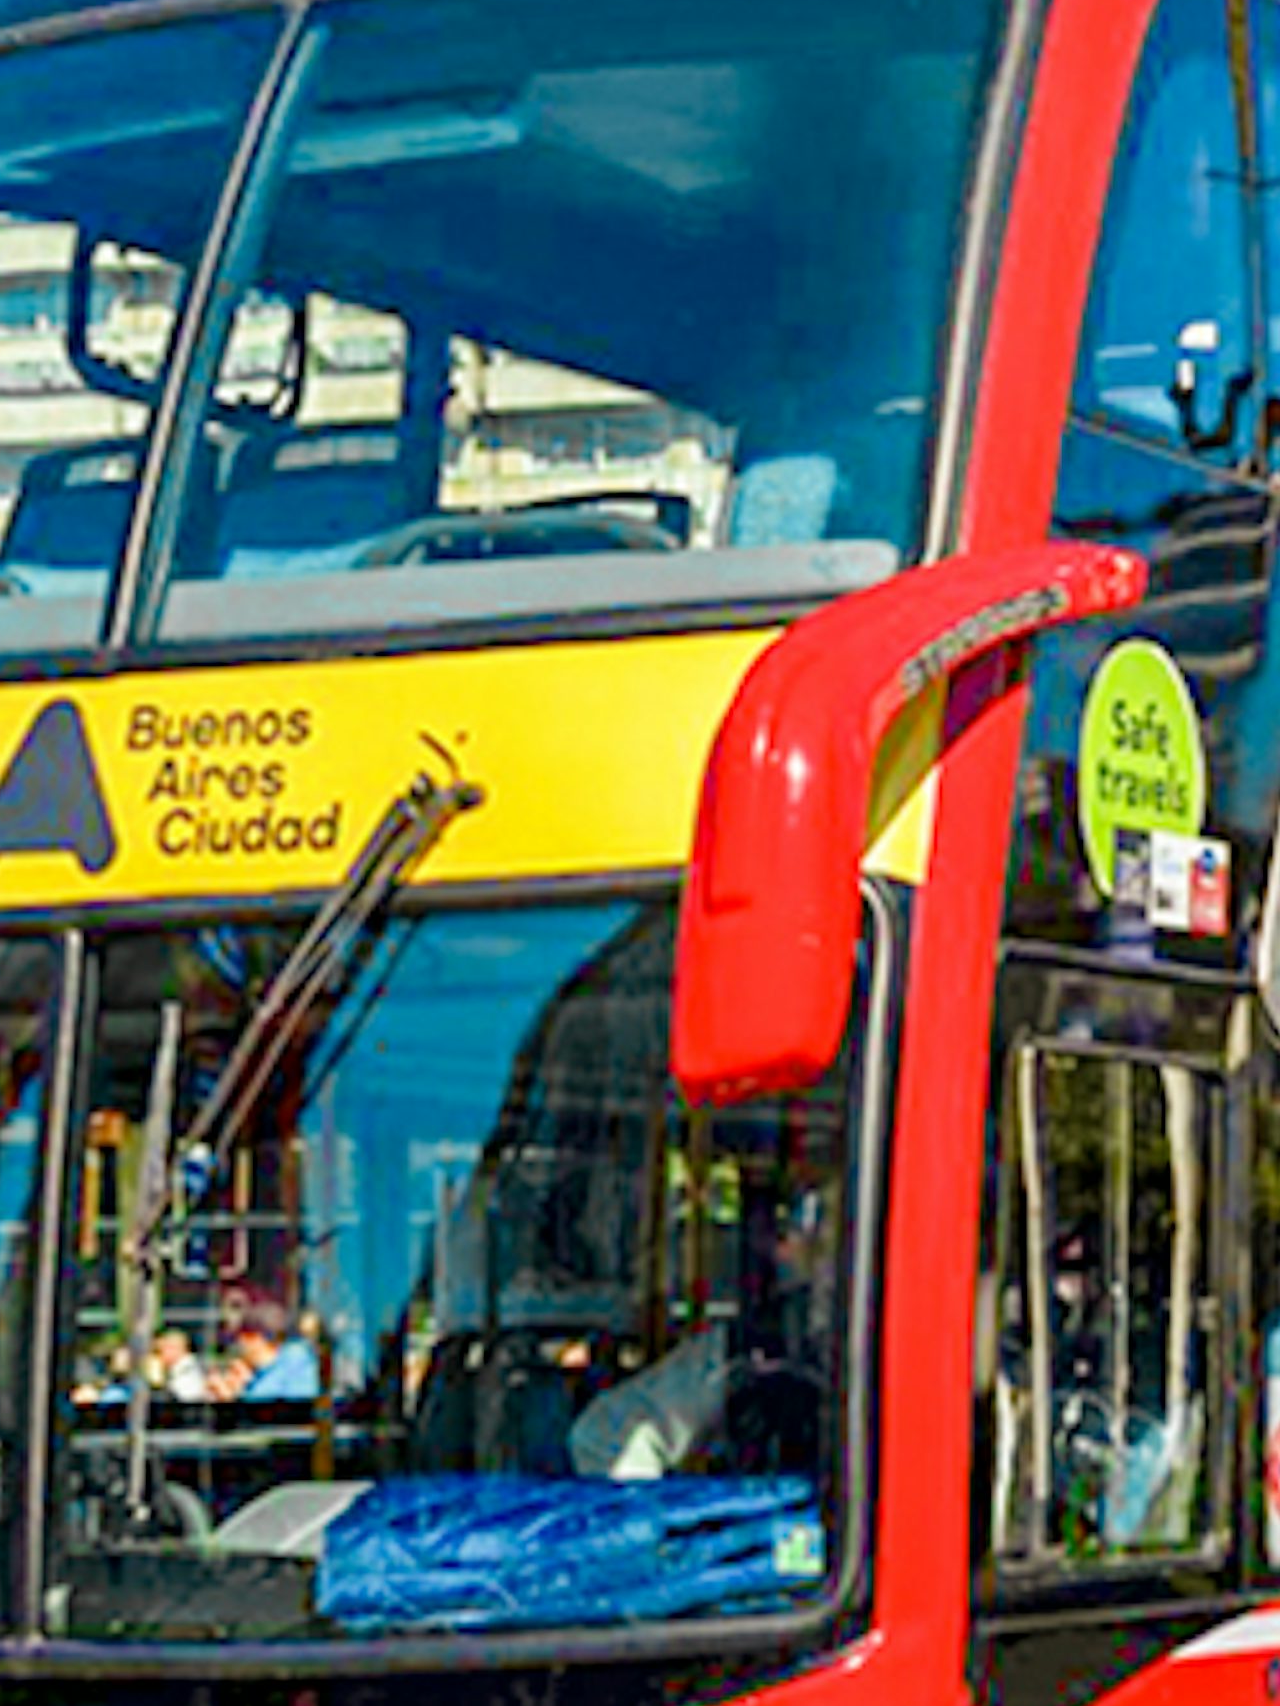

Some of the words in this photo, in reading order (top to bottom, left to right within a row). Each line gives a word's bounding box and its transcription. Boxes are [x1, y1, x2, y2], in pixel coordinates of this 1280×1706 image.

[127, 704, 313, 750] Buenos
[1109, 697, 1170, 759] Safe
[147, 756, 286, 801] Aires
[157, 801, 342, 856] Ciudad
